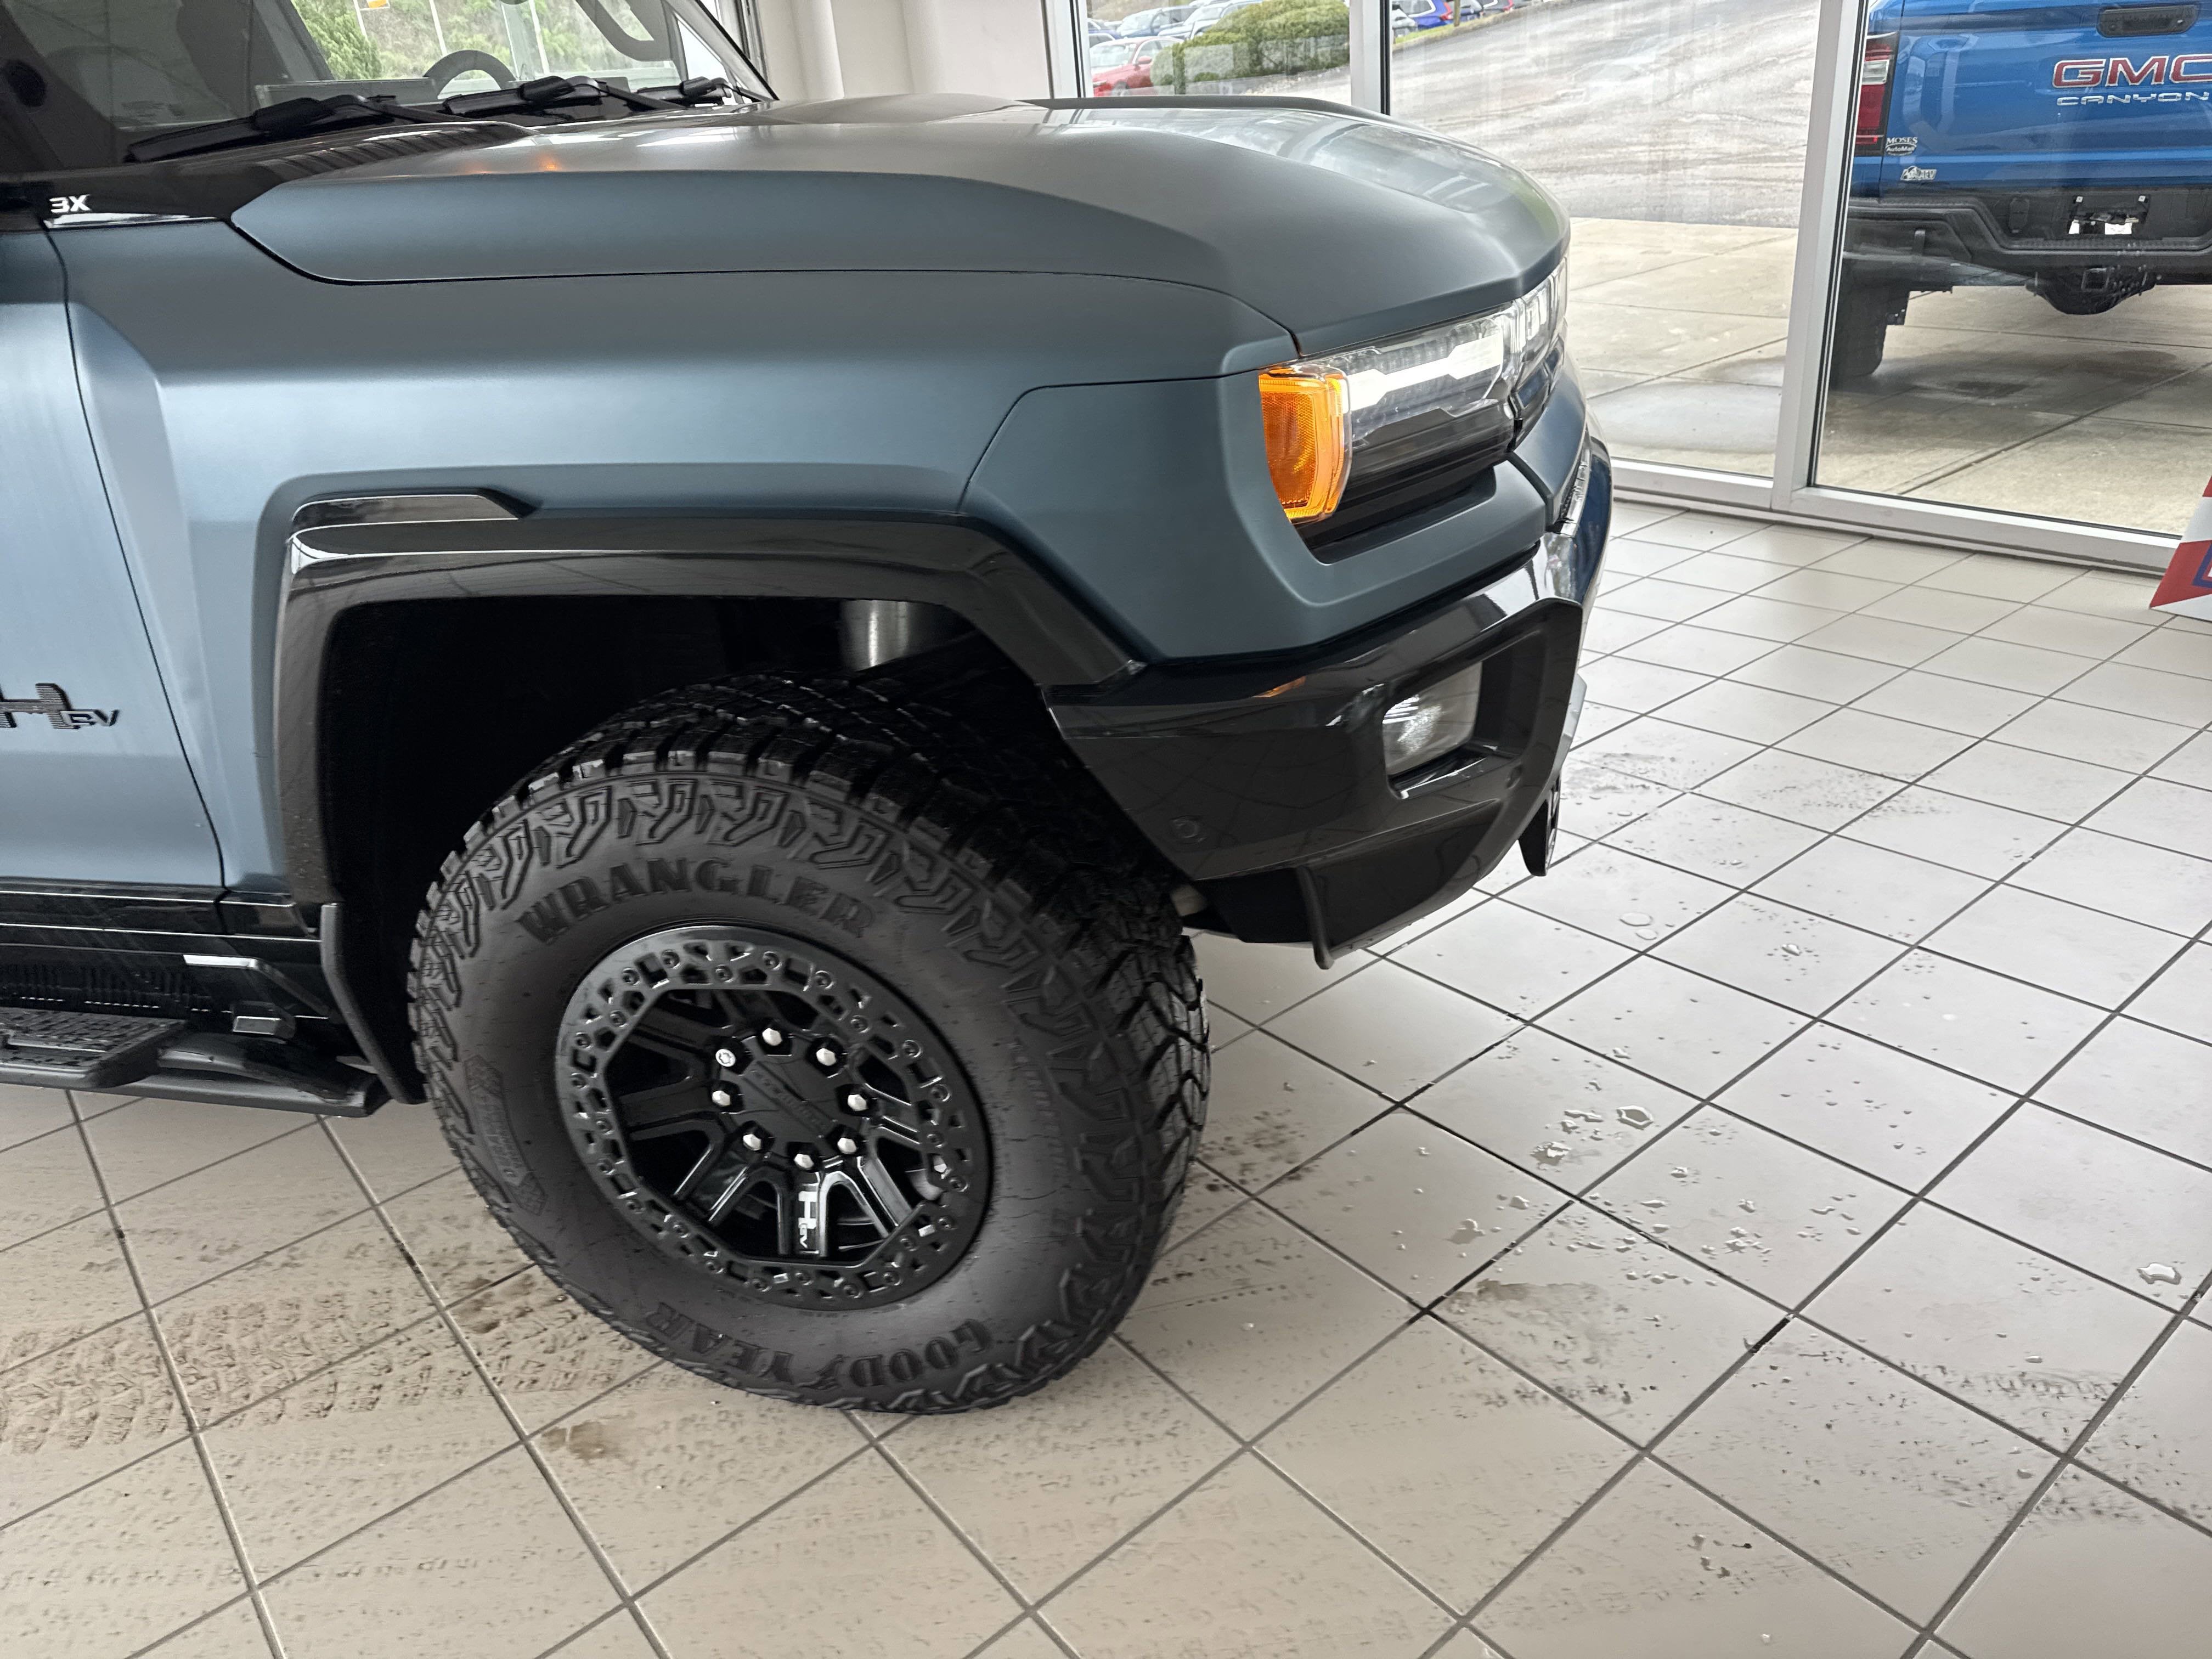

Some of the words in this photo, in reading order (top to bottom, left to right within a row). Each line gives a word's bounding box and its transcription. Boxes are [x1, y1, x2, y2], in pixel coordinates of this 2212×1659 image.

[2053, 53, 2212, 88] GMC
[2057, 92, 2210, 106] CANYON
[49, 194, 91, 213] 3X
[514, 857, 874, 944] WRANGLER
